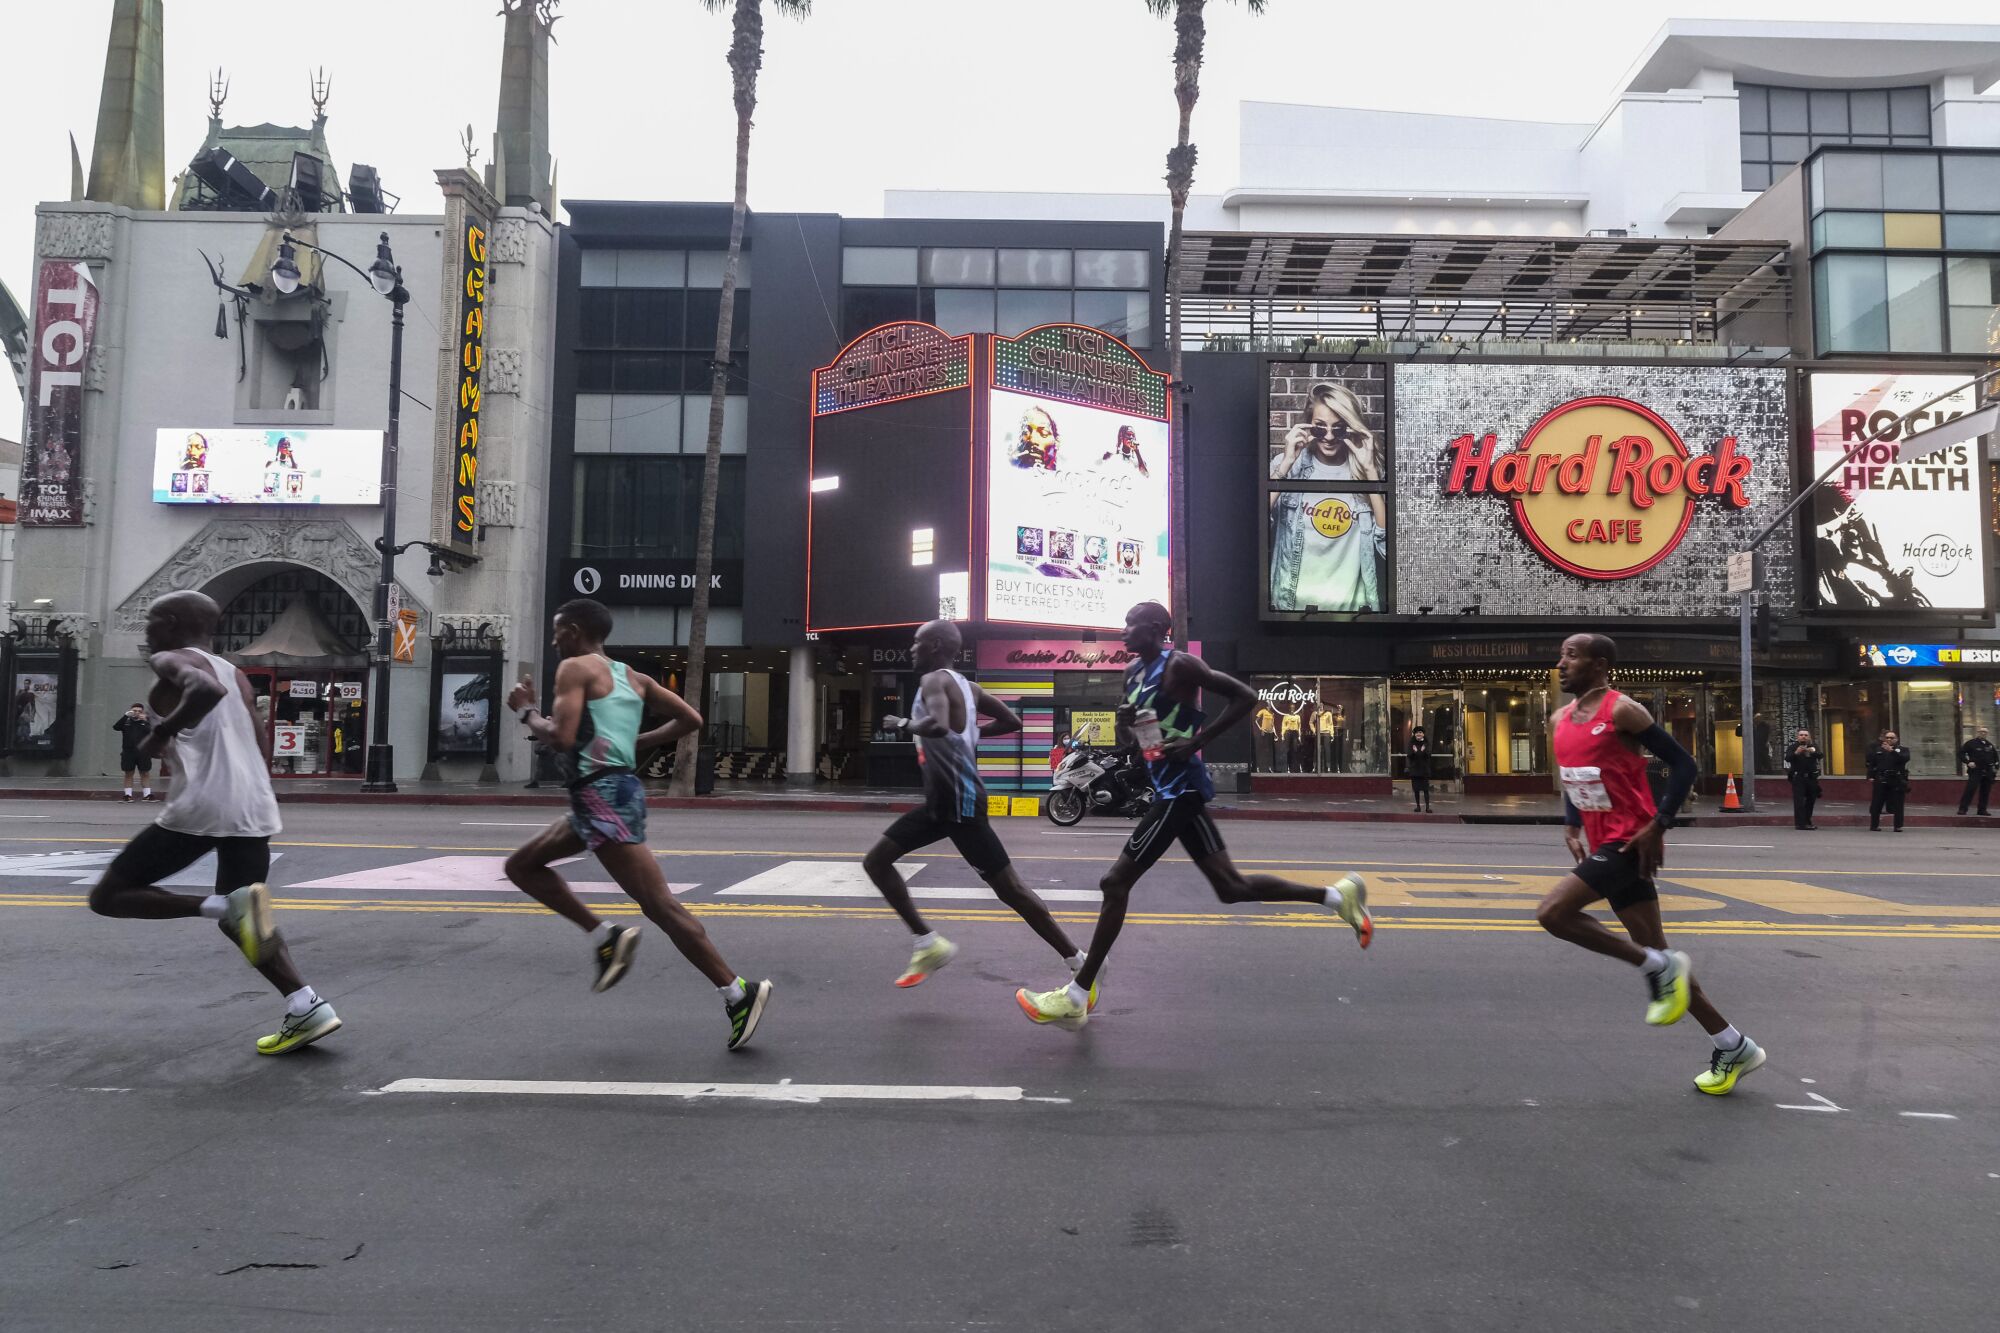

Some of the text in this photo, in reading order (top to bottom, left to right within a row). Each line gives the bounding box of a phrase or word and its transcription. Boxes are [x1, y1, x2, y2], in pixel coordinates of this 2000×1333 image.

[39, 272, 88, 407] TCL
[869, 328, 911, 353] TCL
[1061, 328, 1110, 356] TCL
[841, 342, 941, 380] CHINESE
[1029, 345, 1141, 386] CHINESE
[833, 365, 949, 405] THEATRES
[1018, 365, 1150, 410] THEATRES
[1842, 444, 1968, 466] WOEN'S
[1446, 433, 1754, 509] Hard Rock
[1843, 466, 1970, 491] HEALTH
[38, 484, 67, 495] TCL
[30, 508, 72, 519] IMAX
[1333, 506, 1360, 523] Roc
[1322, 523, 1341, 532] CAFE
[1566, 518, 1643, 544] CAFE
[1902, 542, 1973, 560] Hard Rock
[619, 574, 722, 589] DINING DK
[996, 579, 1105, 600] BUY TICKETS NOW
[996, 593, 1060, 609] PREFERRED
[805, 633, 820, 641] TCL
[873, 649, 907, 662] BOX
[1006, 649, 1057, 664] Cookie
[1057, 649, 1108, 669] Dough
[1432, 644, 1463, 658] MESSI
[1466, 642, 1529, 657] COLLECTION
[1257, 688, 1316, 704] Hard Rock
